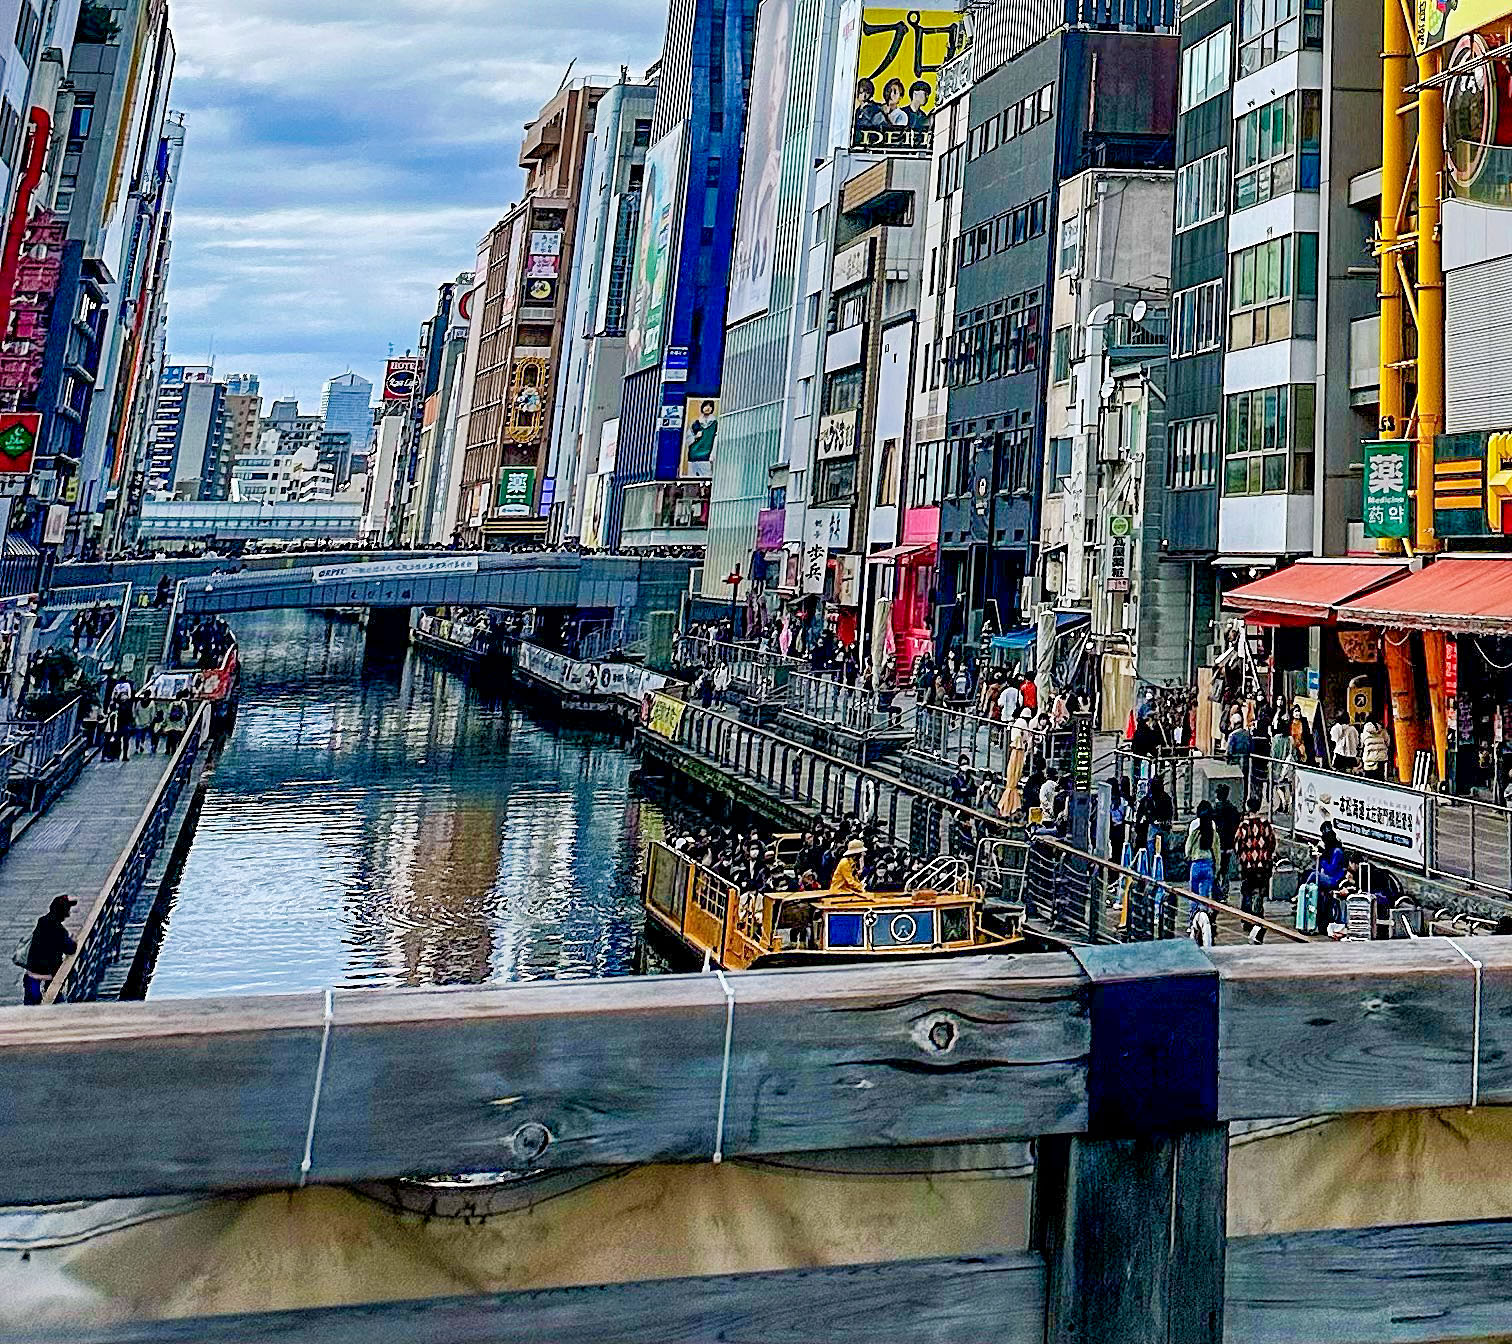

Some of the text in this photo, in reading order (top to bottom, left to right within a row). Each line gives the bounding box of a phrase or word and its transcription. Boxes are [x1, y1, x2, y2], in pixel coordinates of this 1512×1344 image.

[1369, 454, 1404, 493] 薬
[1368, 496, 1404, 505] Medicine
[1368, 506, 1384, 525] 药
[1388, 506, 1403, 526] 약
[805, 544, 825, 581] 歩兵
